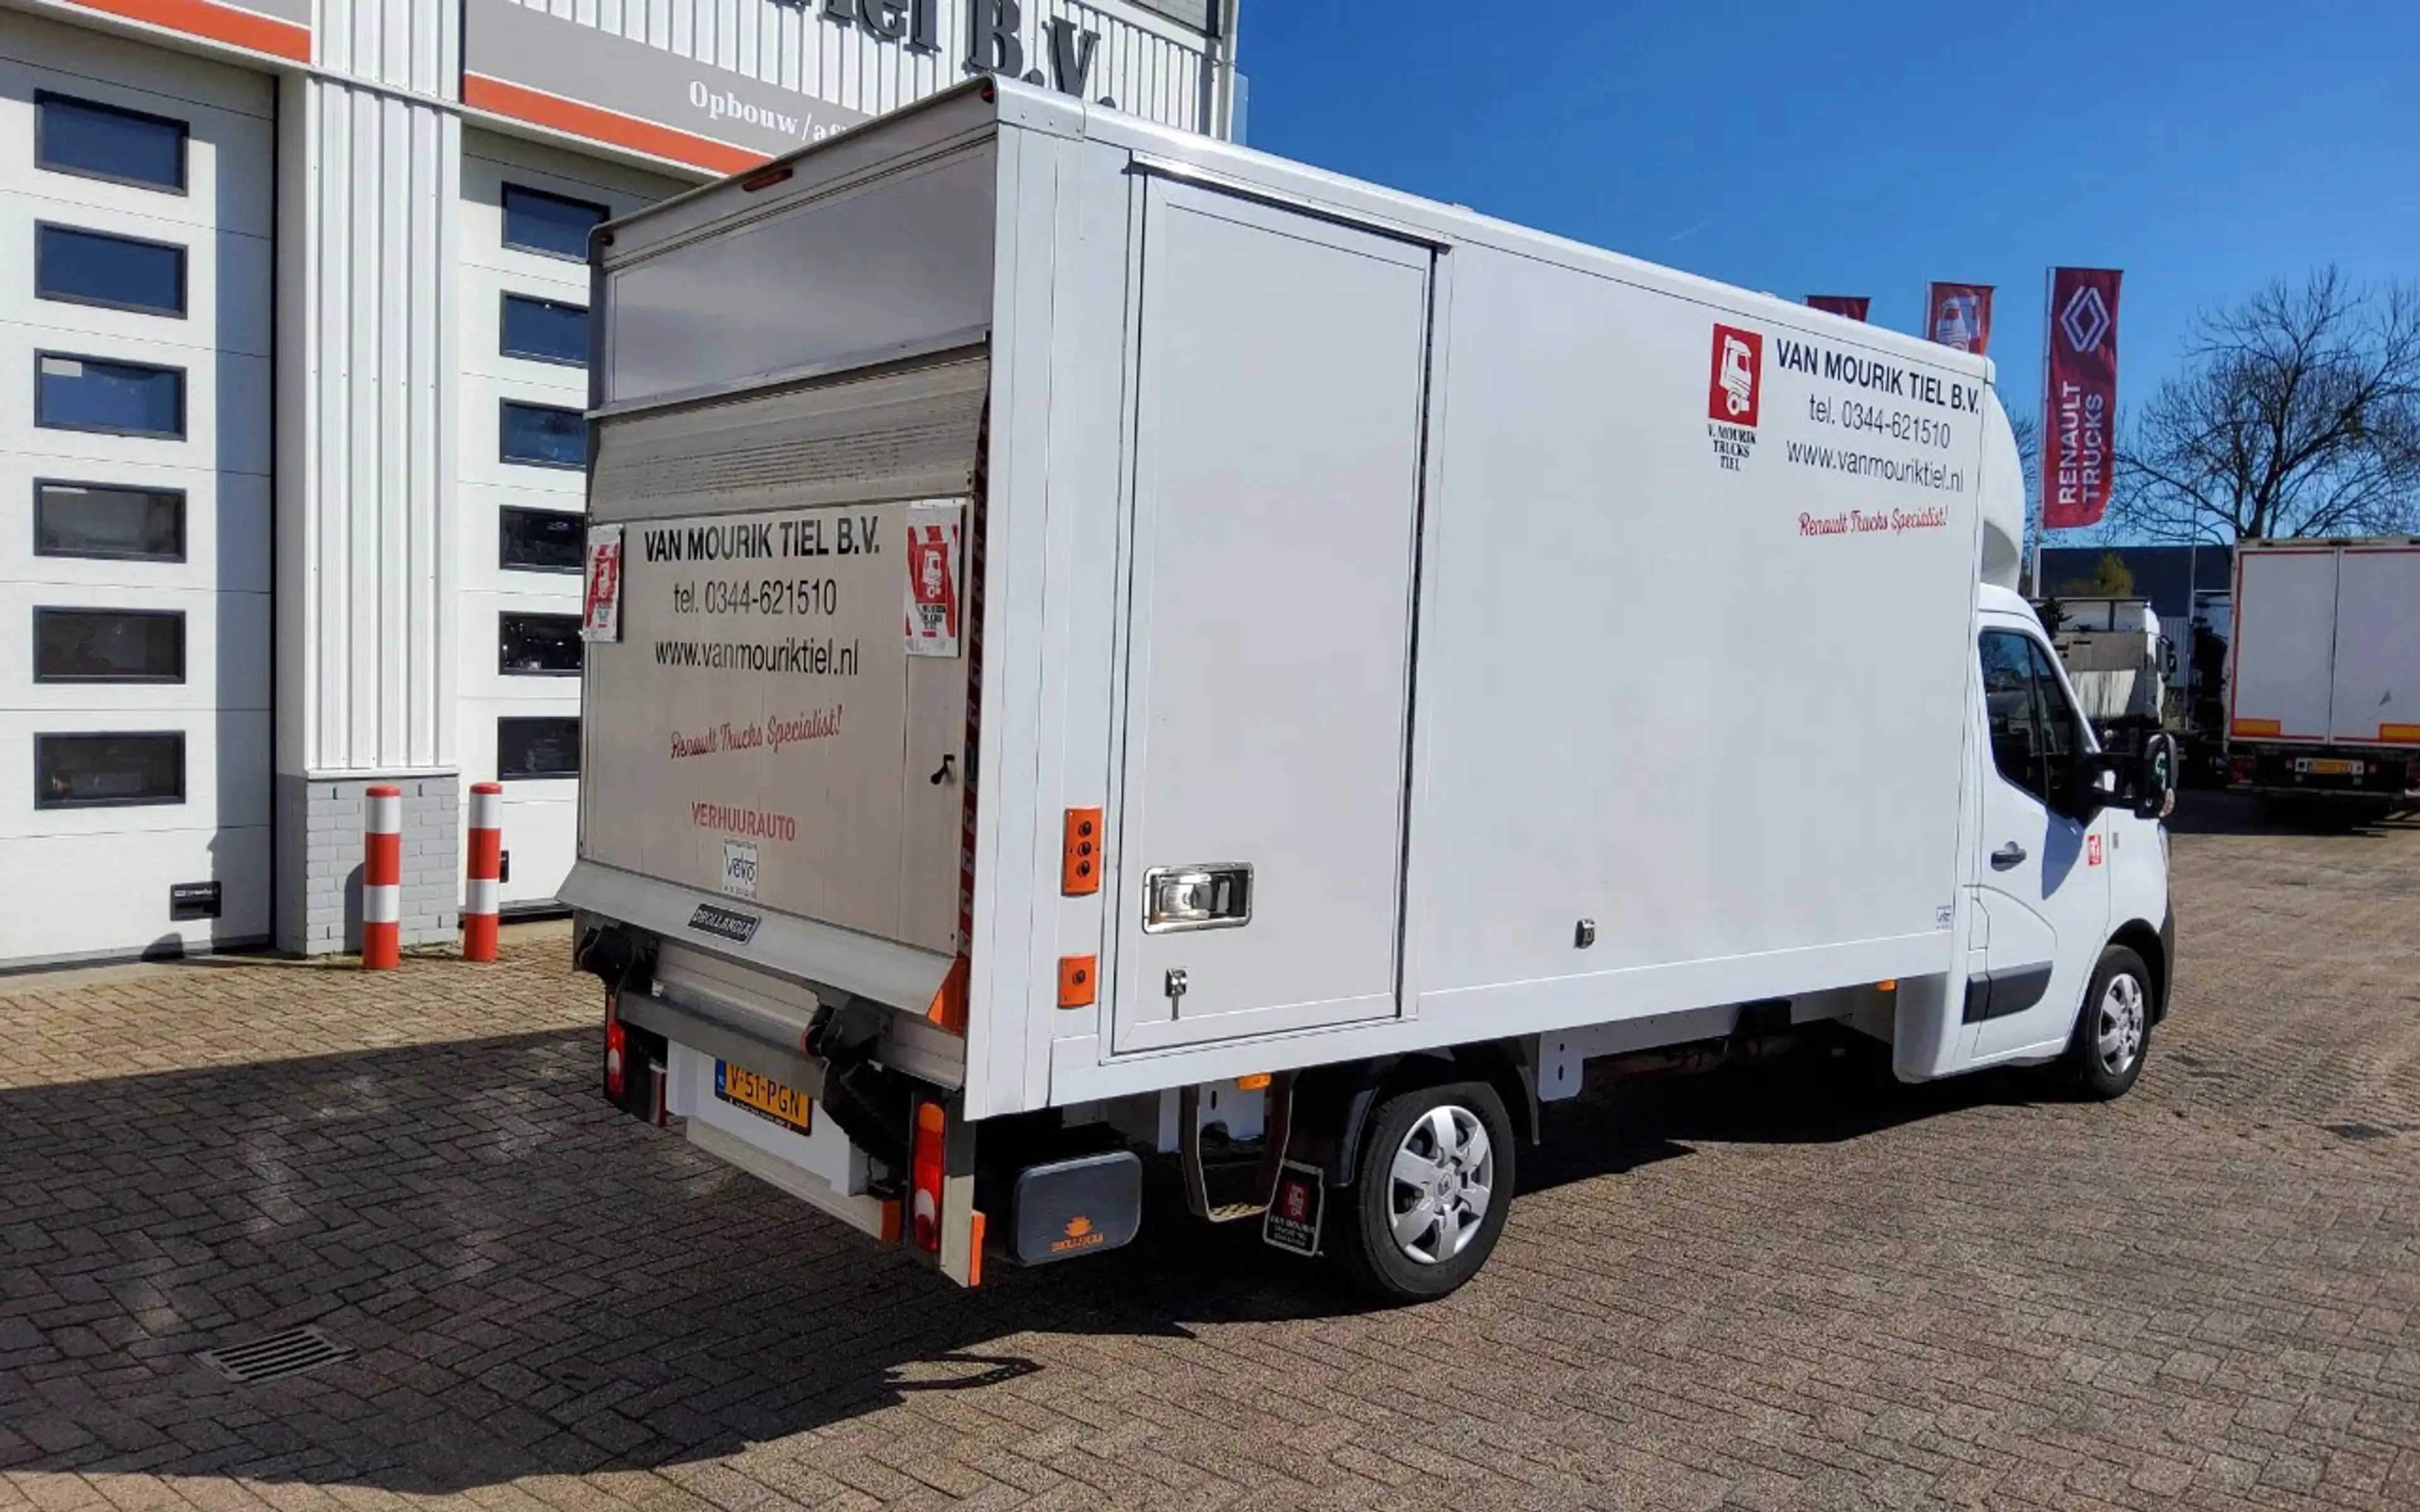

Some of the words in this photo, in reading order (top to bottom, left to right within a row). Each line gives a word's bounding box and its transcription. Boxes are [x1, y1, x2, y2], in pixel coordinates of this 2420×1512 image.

[1777, 338, 1818, 375] VAN
[1825, 351, 1903, 396] MOURIK
[1910, 372, 1945, 406] TIEL
[1951, 383, 1979, 414] B.V.
[1809, 394, 1835, 424] tel.
[1841, 401, 1950, 449] 0344-621510
[2058, 381, 2080, 503] RENAULT
[1713, 440, 1750, 458] TRUCKS
[1720, 455, 1740, 471] TIEL
[1787, 440, 1963, 492] www.vanmouriktiel.nl
[2082, 394, 2103, 503] TRUCKS
[645, 529, 681, 562] VAN
[688, 523, 773, 561] MOURIK
[780, 520, 829, 557] TIEL
[838, 516, 880, 554] B.V.
[1799, 512, 1848, 536] Renault
[1851, 510, 1887, 532] Trucks
[1892, 505, 1948, 536] Specialist!
[674, 580, 698, 614] tel.
[705, 578, 837, 616] 0344-621510
[655, 637, 859, 675] www.vanmouriktiel.nl
[671, 726, 717, 759] Renault
[720, 721, 763, 752] Trucks
[768, 704, 842, 753] Specialist!
[691, 801, 795, 841] VERHUURAUTO
[730, 1064, 800, 1118] V-51-PGN
